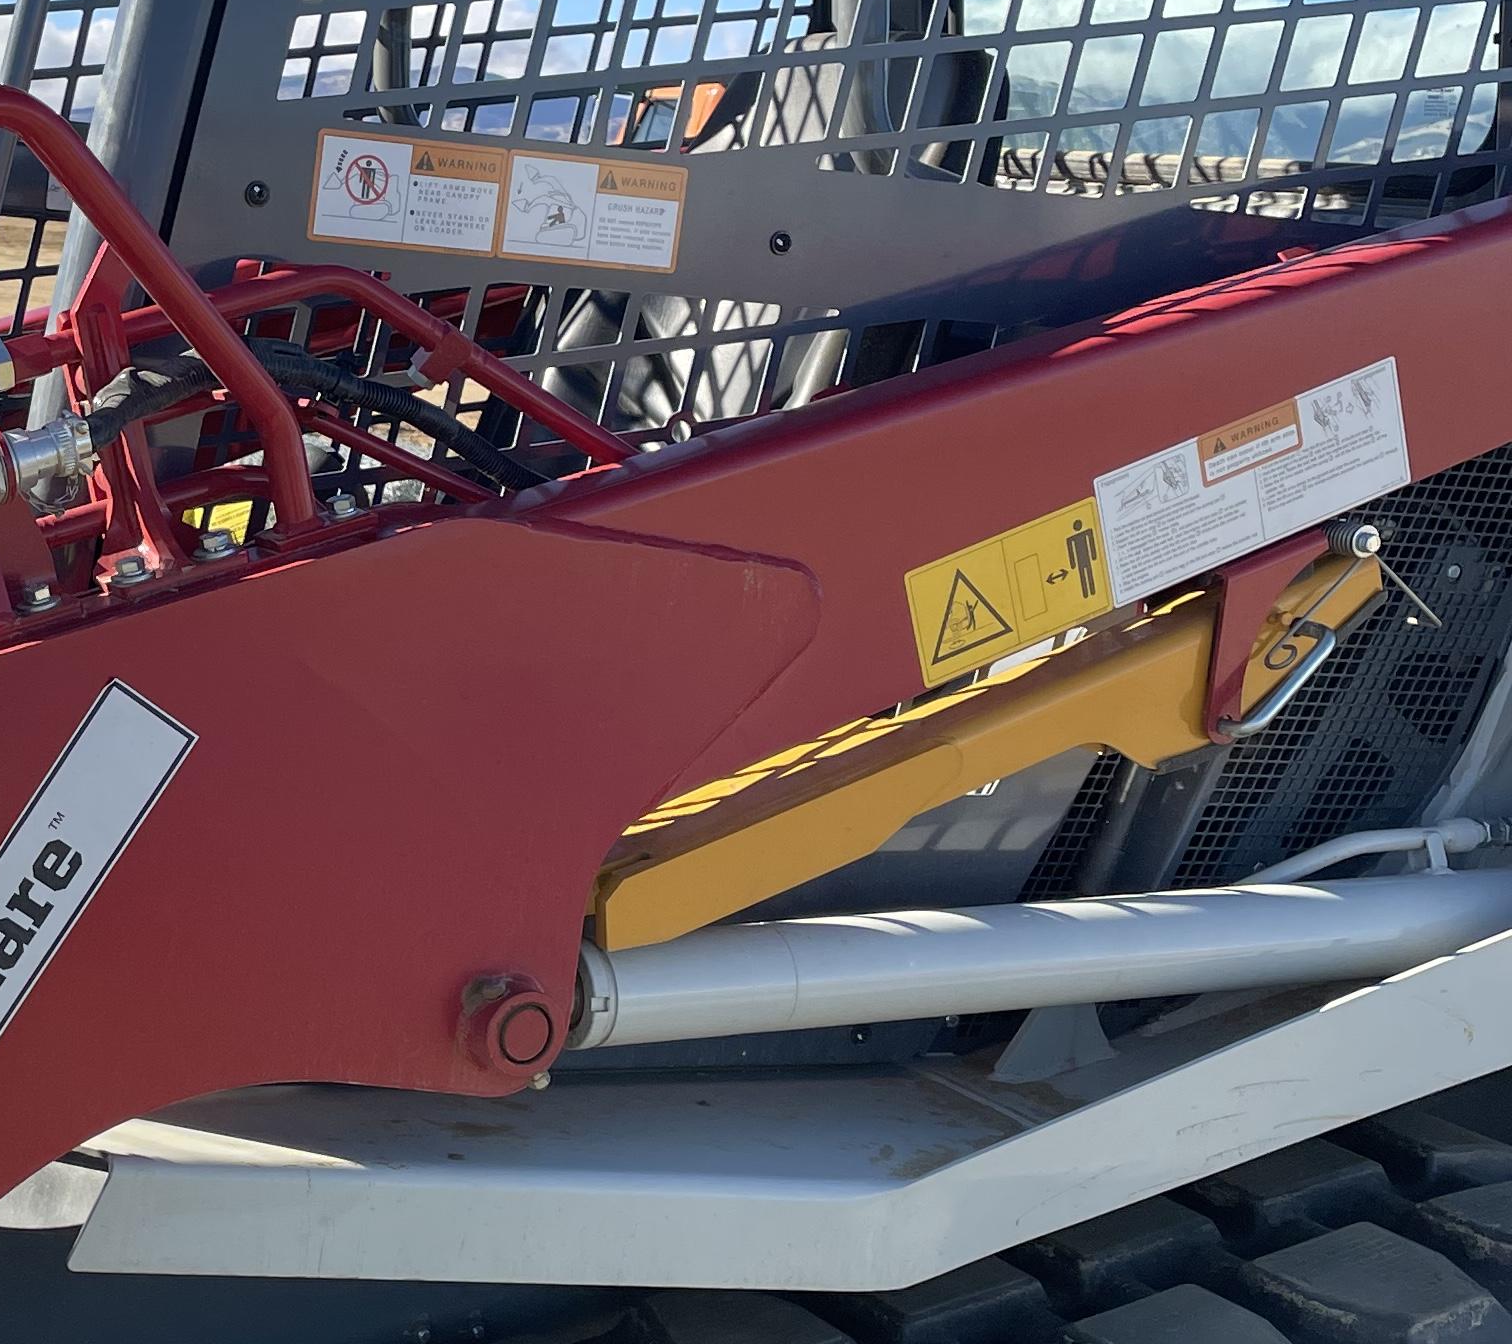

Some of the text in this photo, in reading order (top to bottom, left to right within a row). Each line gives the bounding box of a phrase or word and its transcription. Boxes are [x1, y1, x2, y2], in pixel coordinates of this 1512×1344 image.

[438, 157, 497, 173] WARNING
[621, 177, 677, 192] WARNING
[608, 203, 666, 216] CRUSH HAZARD
[1230, 416, 1279, 442] WARNING
